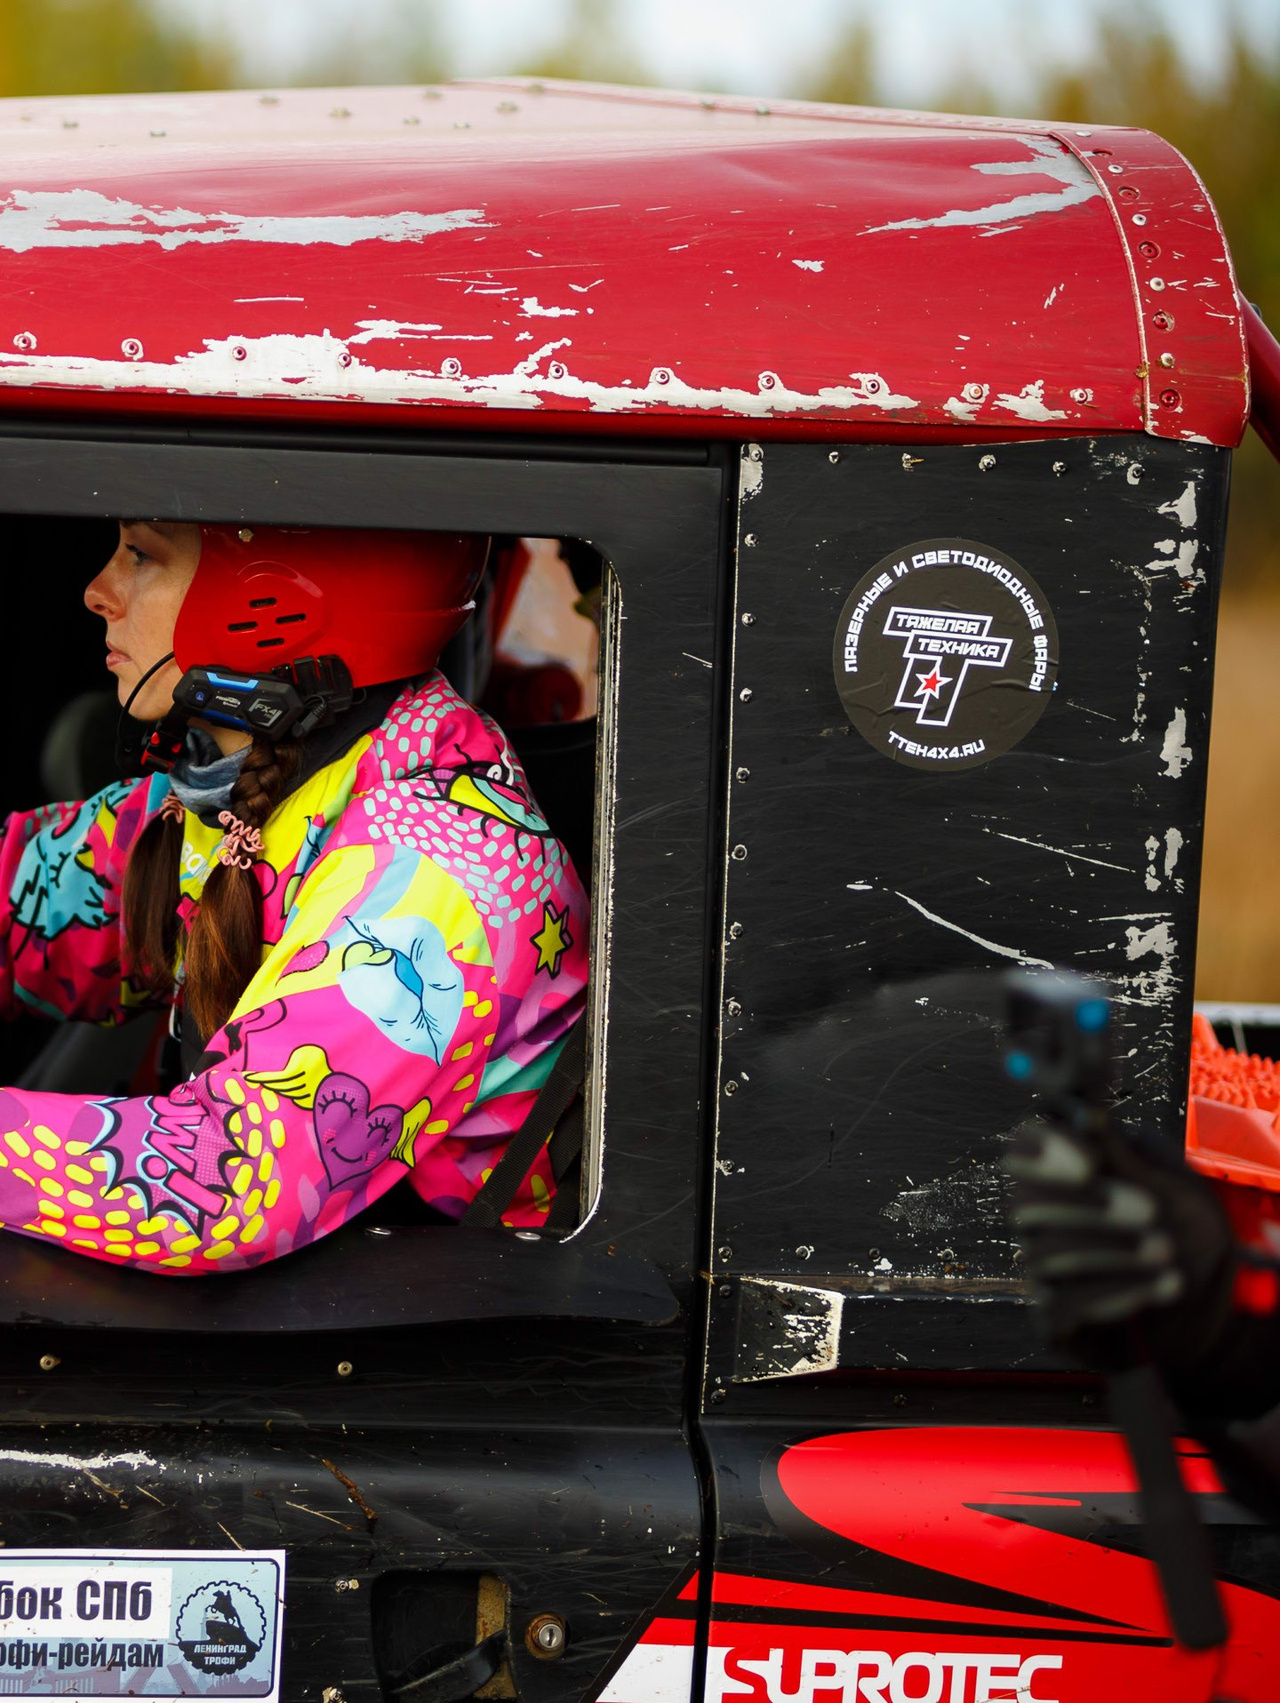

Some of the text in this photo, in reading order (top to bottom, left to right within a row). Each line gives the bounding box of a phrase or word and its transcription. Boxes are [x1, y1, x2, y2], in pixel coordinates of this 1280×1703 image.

[844, 550, 1048, 692] ЛАЗЕРНЫЕ И СВЕТОДИОДНЫЕ ФАРЫ
[896, 613, 981, 635] ТЯЖЕЛАЯ
[918, 637, 1001, 658] ТЕХНИКА
[76, 1580, 152, 1621] СПб
[194, 1644, 247, 1653] ЛЕНИНГРАД
[204, 1657, 236, 1666] ТРОФИ
[723, 1648, 1063, 1702] SUPROTEC
